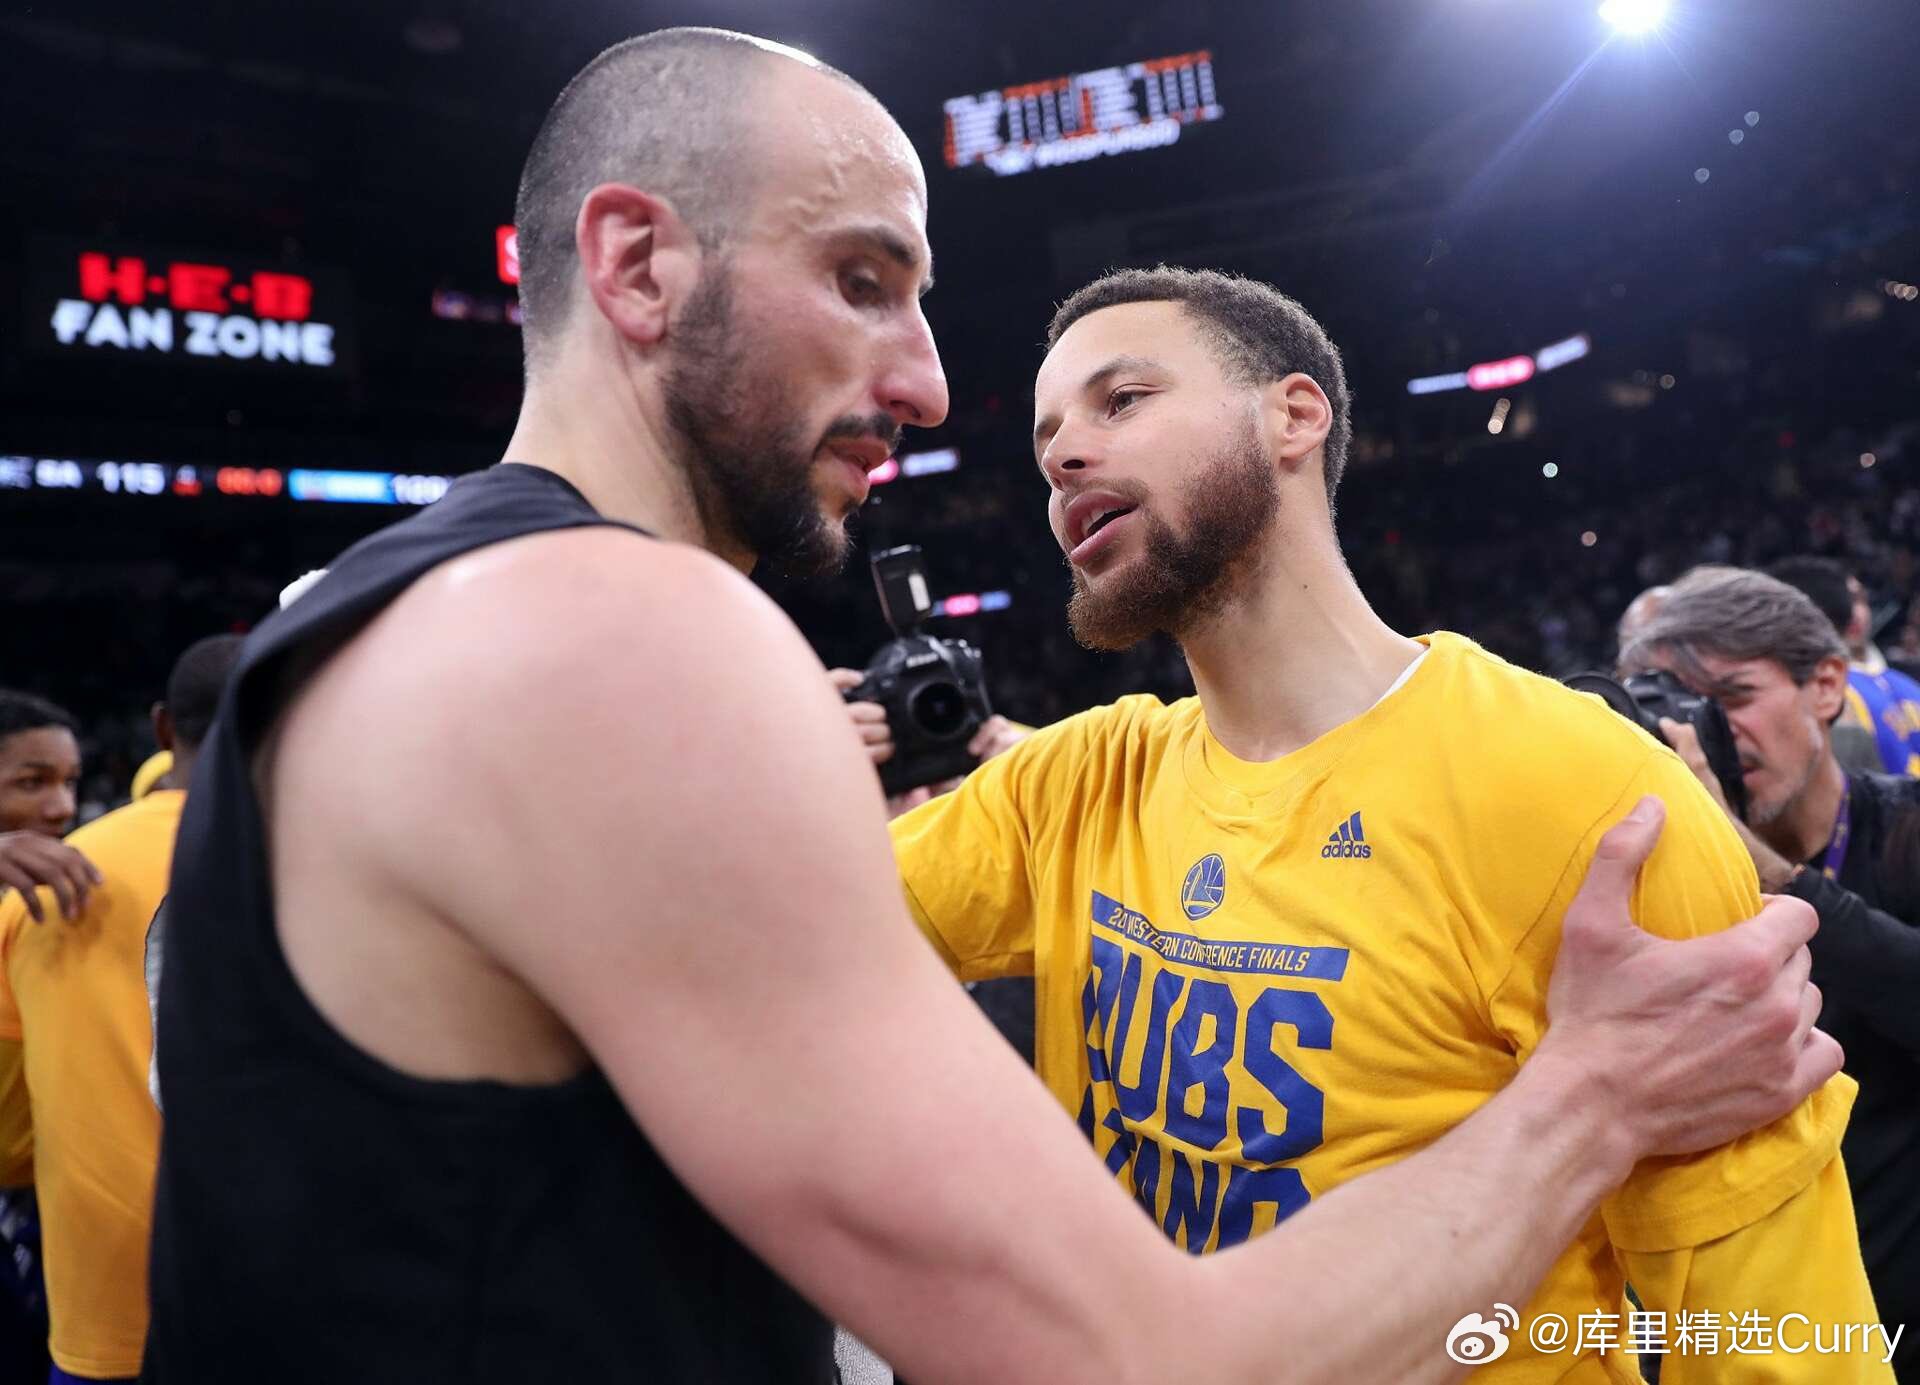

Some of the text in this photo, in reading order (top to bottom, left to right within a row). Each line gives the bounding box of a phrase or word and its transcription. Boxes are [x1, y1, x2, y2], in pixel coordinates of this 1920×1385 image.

[51, 298, 335, 366] FAN ZONE
[1321, 840, 1372, 859] adidas
[1126, 914, 1181, 958] WESTERN
[1180, 939, 1247, 969] CONFRENCE
[1247, 947, 1311, 972] FINALS
